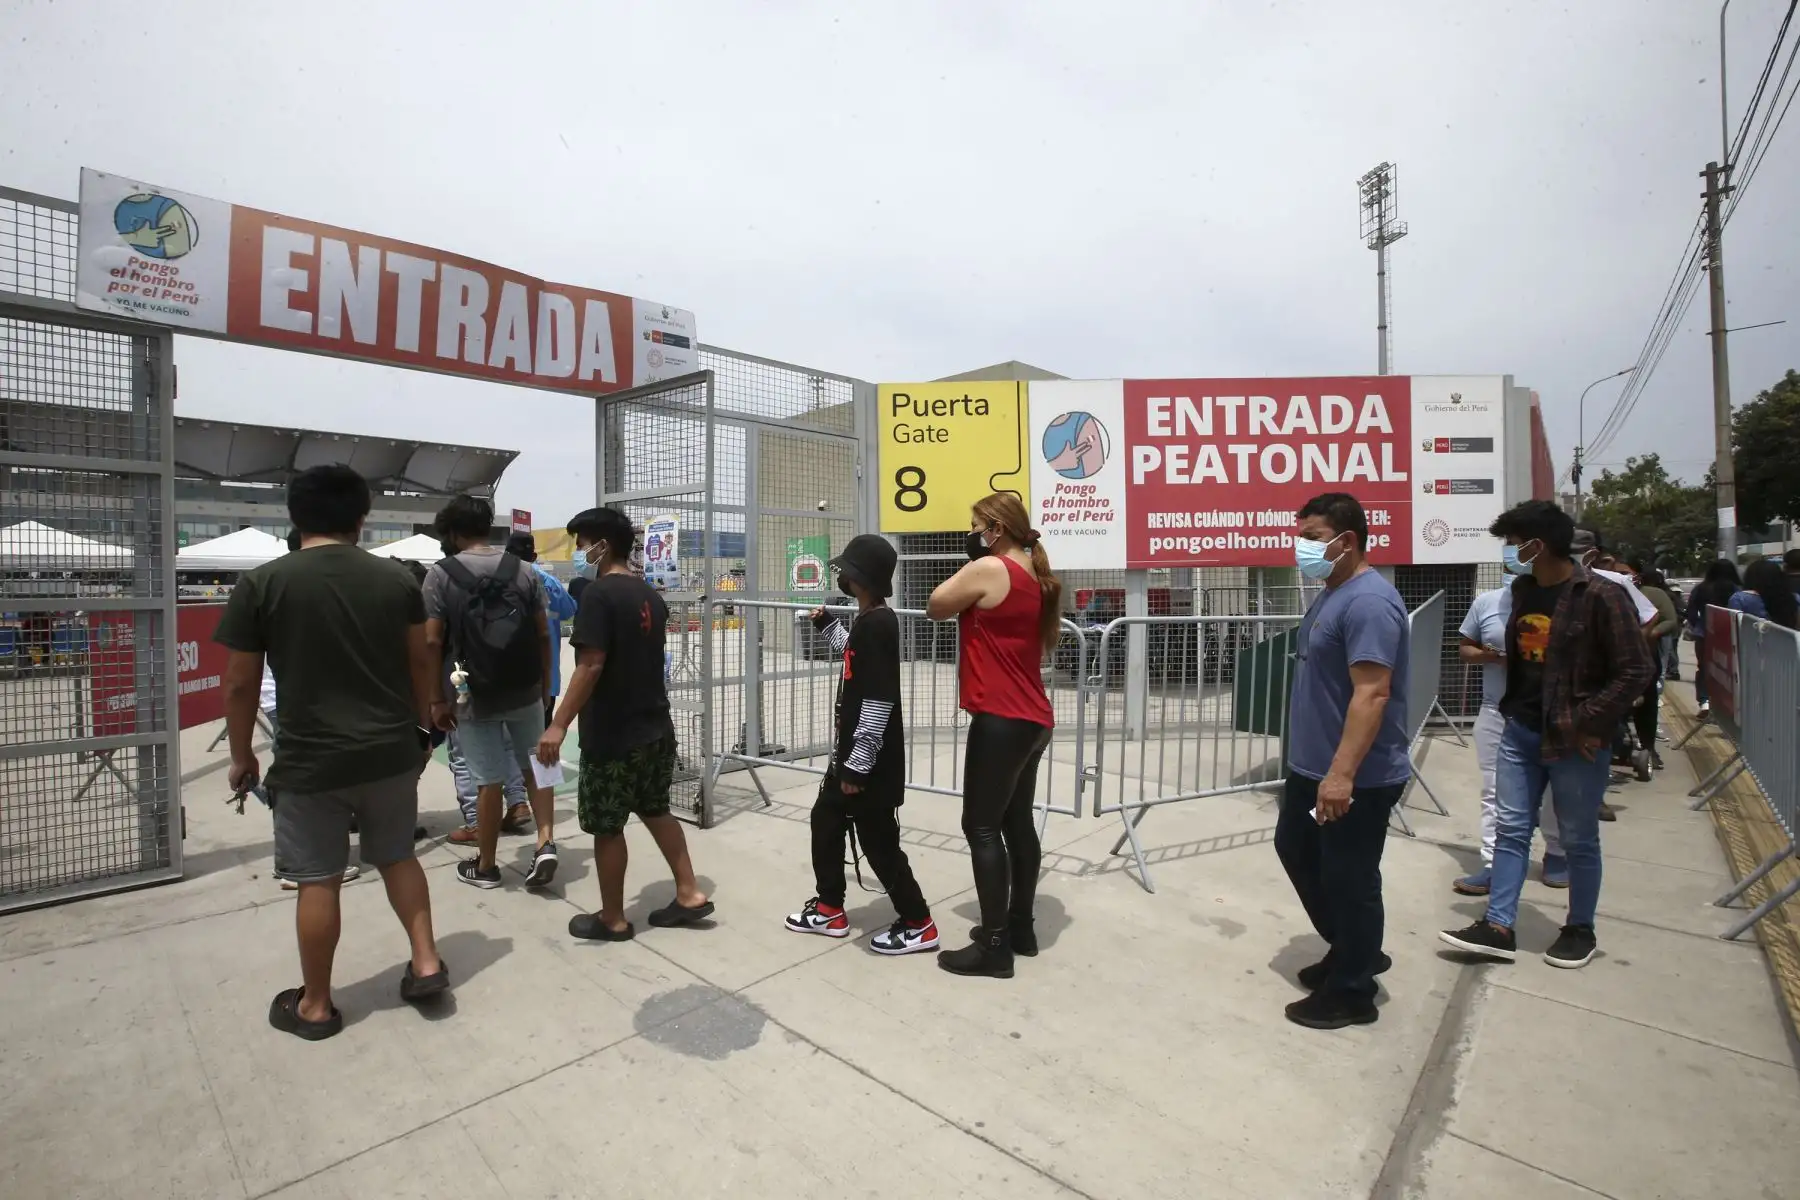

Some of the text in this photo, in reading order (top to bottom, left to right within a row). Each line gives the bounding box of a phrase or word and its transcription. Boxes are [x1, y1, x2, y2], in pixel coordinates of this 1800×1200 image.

[128, 256, 179, 276] Pongo
[110, 267, 195, 291] el hombro
[107, 281, 199, 305] por el Perú
[116, 298, 190, 317] YO ME VACUNO
[259, 225, 617, 384] ENTRADA
[892, 393, 990, 418] Puerta
[1147, 394, 1394, 438] ENTRADA
[1424, 404, 1458, 413] Gobierno
[893, 423, 949, 444] Gate
[1132, 442, 1408, 485] PEATONAL
[894, 466, 928, 513] 8
[1055, 483, 1097, 497] Pongo
[1042, 496, 1110, 508] el hombro
[1041, 509, 1114, 525] por el Perú
[1147, 512, 1193, 529] REVISA
[1194, 509, 1245, 528] CUÁNDO
[1246, 511, 1255, 527] Y
[1256, 508, 1298, 527] DÓNDE
[1371, 509, 1392, 526] EN:
